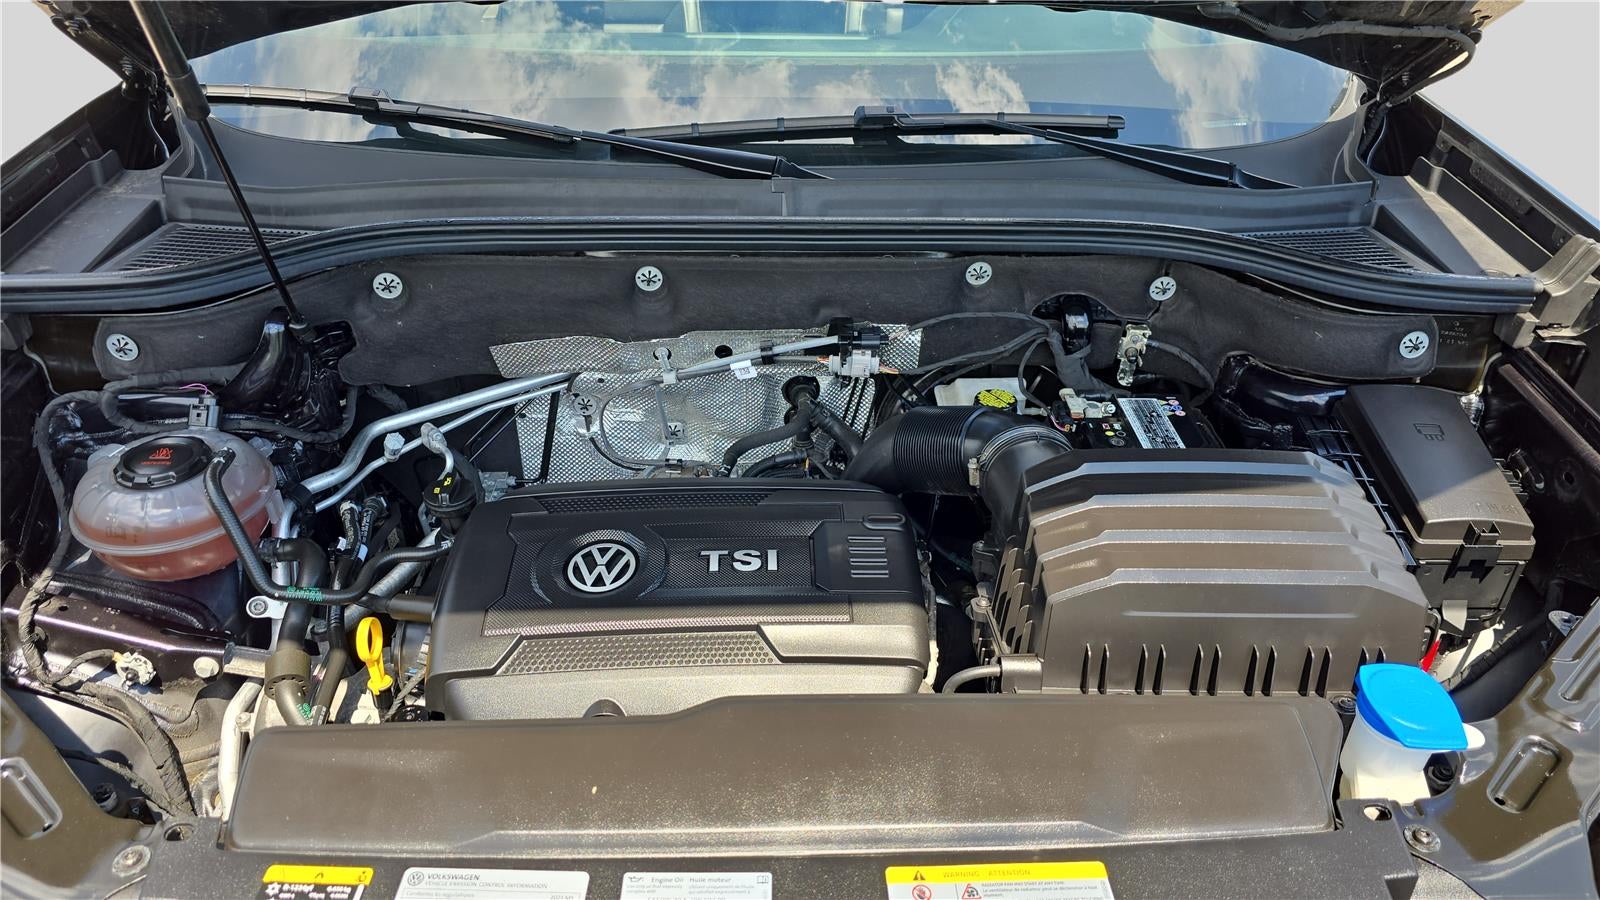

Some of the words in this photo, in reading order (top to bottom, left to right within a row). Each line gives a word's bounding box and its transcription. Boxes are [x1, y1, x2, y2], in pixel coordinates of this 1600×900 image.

[700, 549, 778, 572] TSI
[427, 873, 481, 881] VOLKSWAGEN
[988, 869, 1031, 877] ATTENTION
